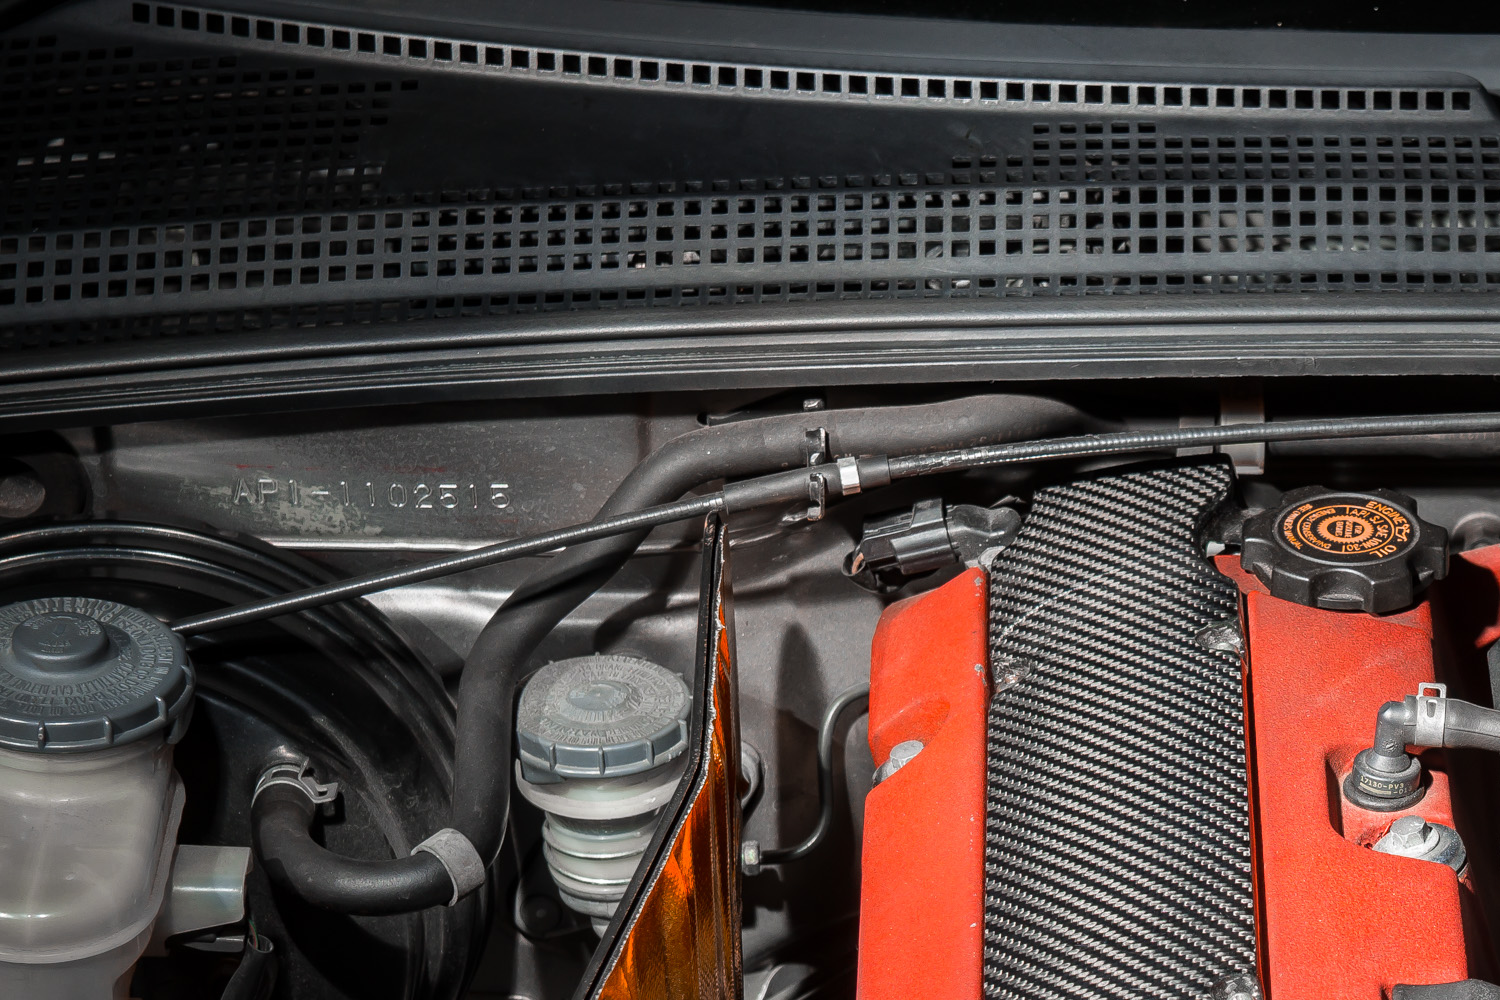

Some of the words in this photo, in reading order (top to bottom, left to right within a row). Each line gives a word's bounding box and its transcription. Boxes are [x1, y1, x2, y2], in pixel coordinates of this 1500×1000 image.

[233, 479, 511, 509] AP1-1102515
[1350, 509, 1370, 518] API
[1366, 501, 1407, 525] ENGINE
[1369, 545, 1397, 558] OIL
[33, 597, 125, 613] ATTENTION
